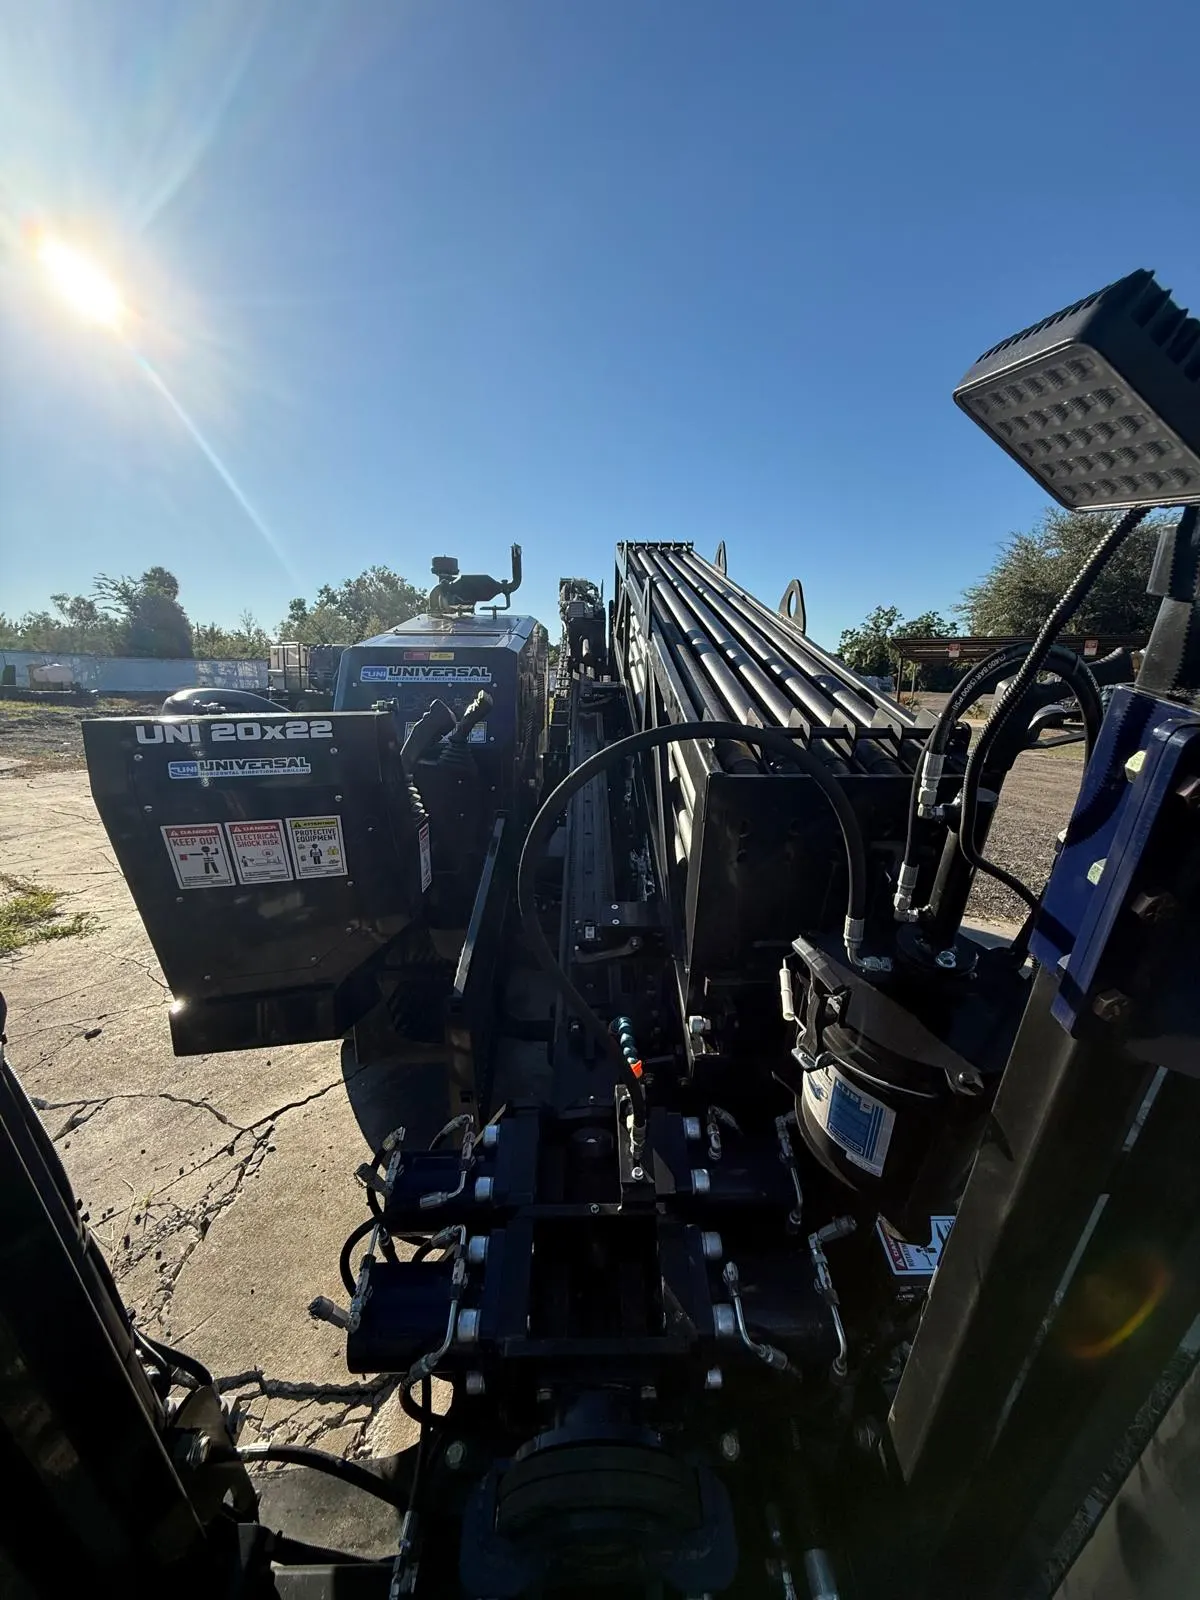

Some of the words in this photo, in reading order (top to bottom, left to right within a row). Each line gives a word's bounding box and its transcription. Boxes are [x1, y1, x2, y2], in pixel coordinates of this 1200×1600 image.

[387, 666, 491, 677] UNIVERSAL
[975, 666, 989, 680] BAR
[960, 677, 978, 697] (5800
[135, 724, 200, 744] UNI
[210, 720, 334, 742] 20x22
[199, 757, 310, 771] UNIVERSAL
[234, 832, 279, 842] ELECTRICAL
[294, 827, 337, 837] PROTECTIVE
[171, 837, 197, 847] KEEP
[200, 836, 218, 846] OUT
[236, 839, 261, 848] SHOCK
[262, 838, 280, 847] RISK
[296, 834, 337, 843] EQUIPMENT
